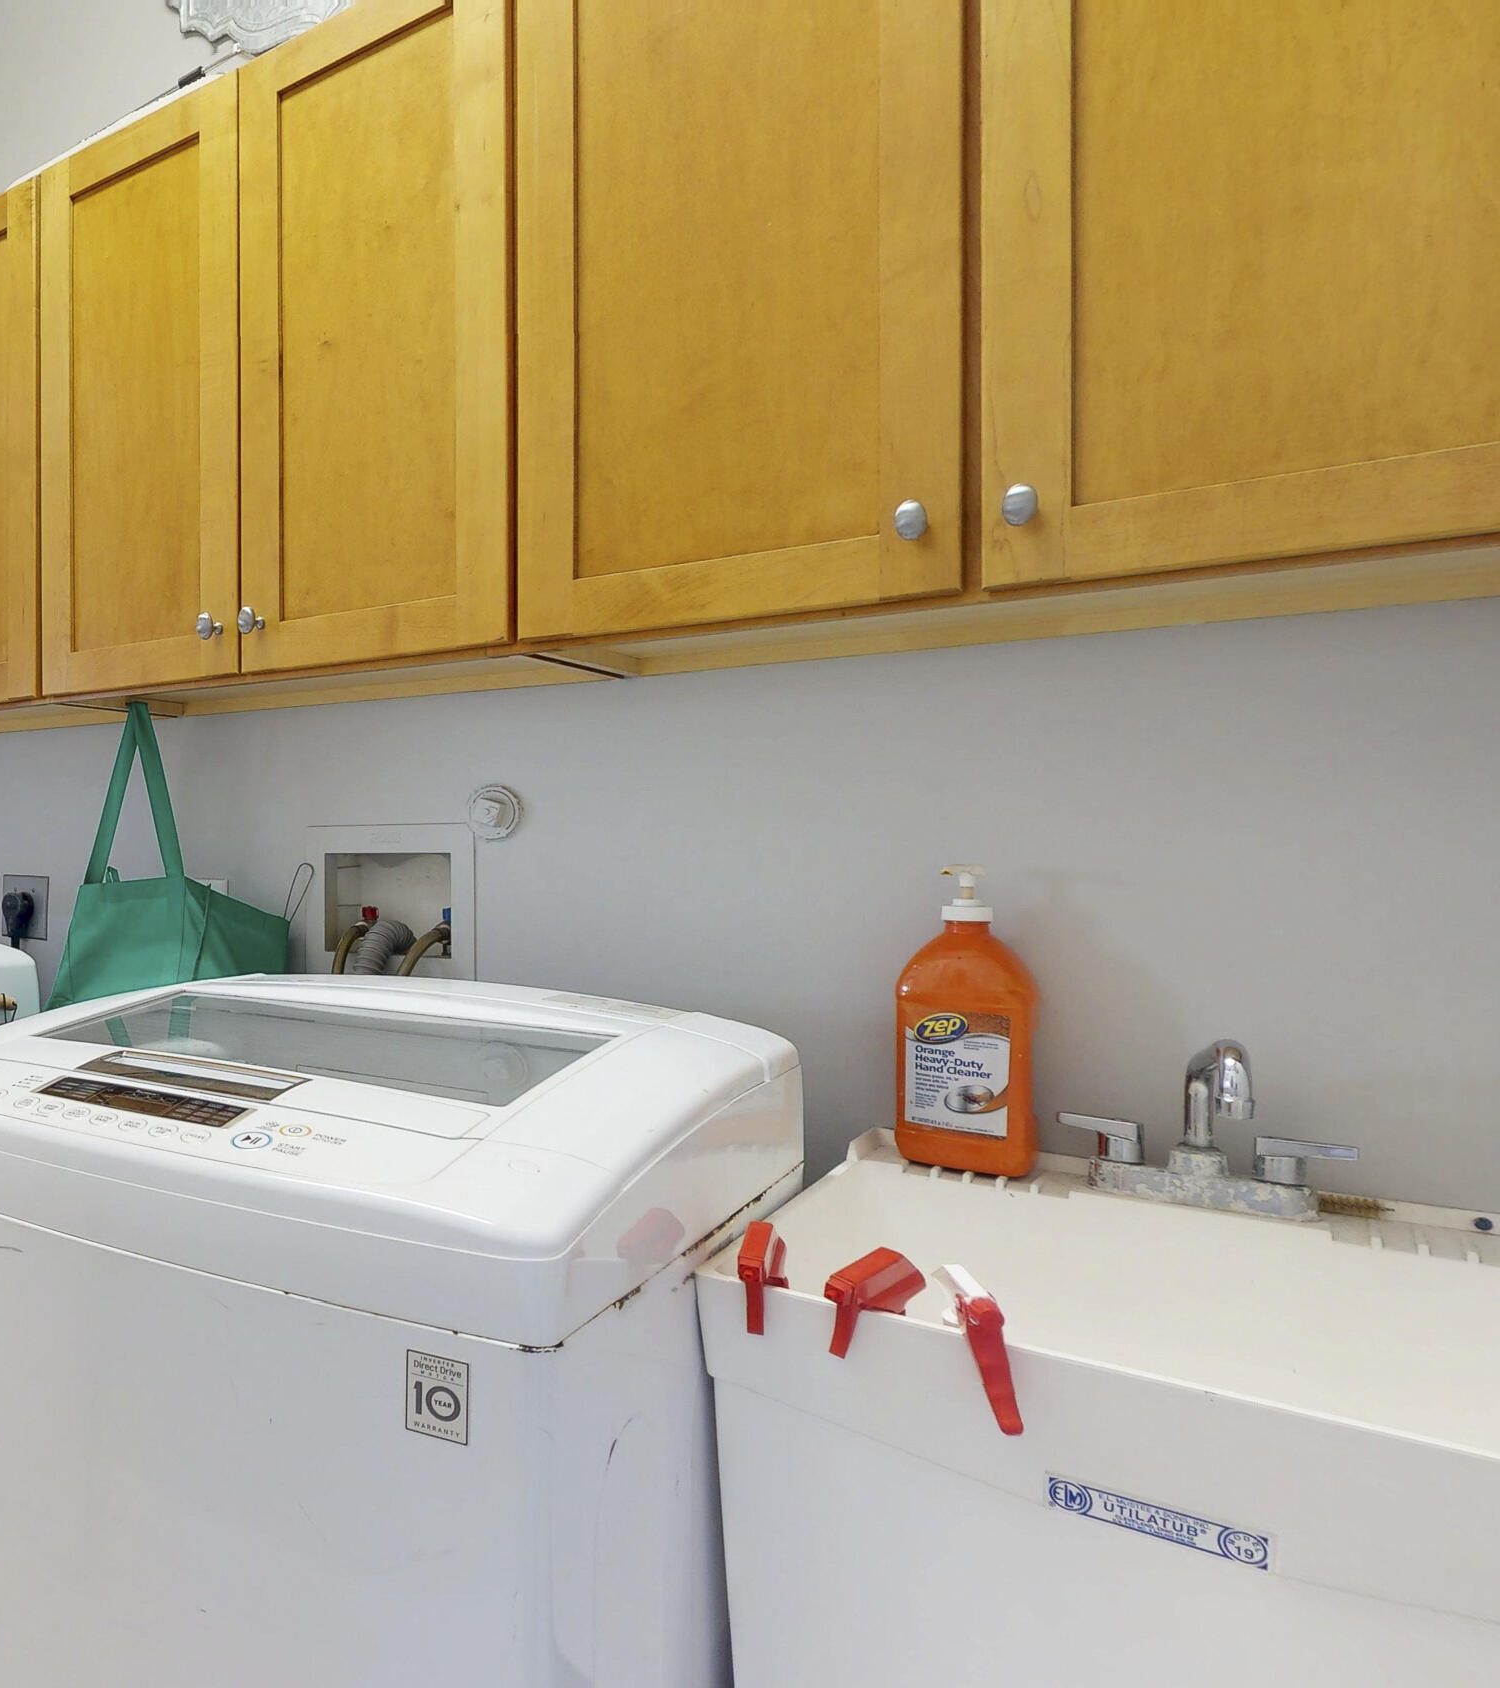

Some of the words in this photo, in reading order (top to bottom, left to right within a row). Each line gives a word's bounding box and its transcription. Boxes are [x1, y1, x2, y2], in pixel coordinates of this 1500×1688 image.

[915, 1044, 956, 1058] Orange
[915, 1053, 984, 1071] Heavy-Duty
[915, 1062, 944, 1074] Hand
[946, 1066, 993, 1079] Cleaner
[413, 1360, 438, 1372] Direct
[439, 1366, 462, 1379] Drive
[420, 1355, 455, 1368] INVERTER
[413, 1380, 462, 1422] 10
[433, 1398, 453, 1409] YEAR
[413, 1420, 461, 1438] WARRANTY
[1053, 1484, 1084, 1509] ELM
[1228, 1534, 1263, 1552] MODEL
[1234, 1546, 1255, 1560] 19
